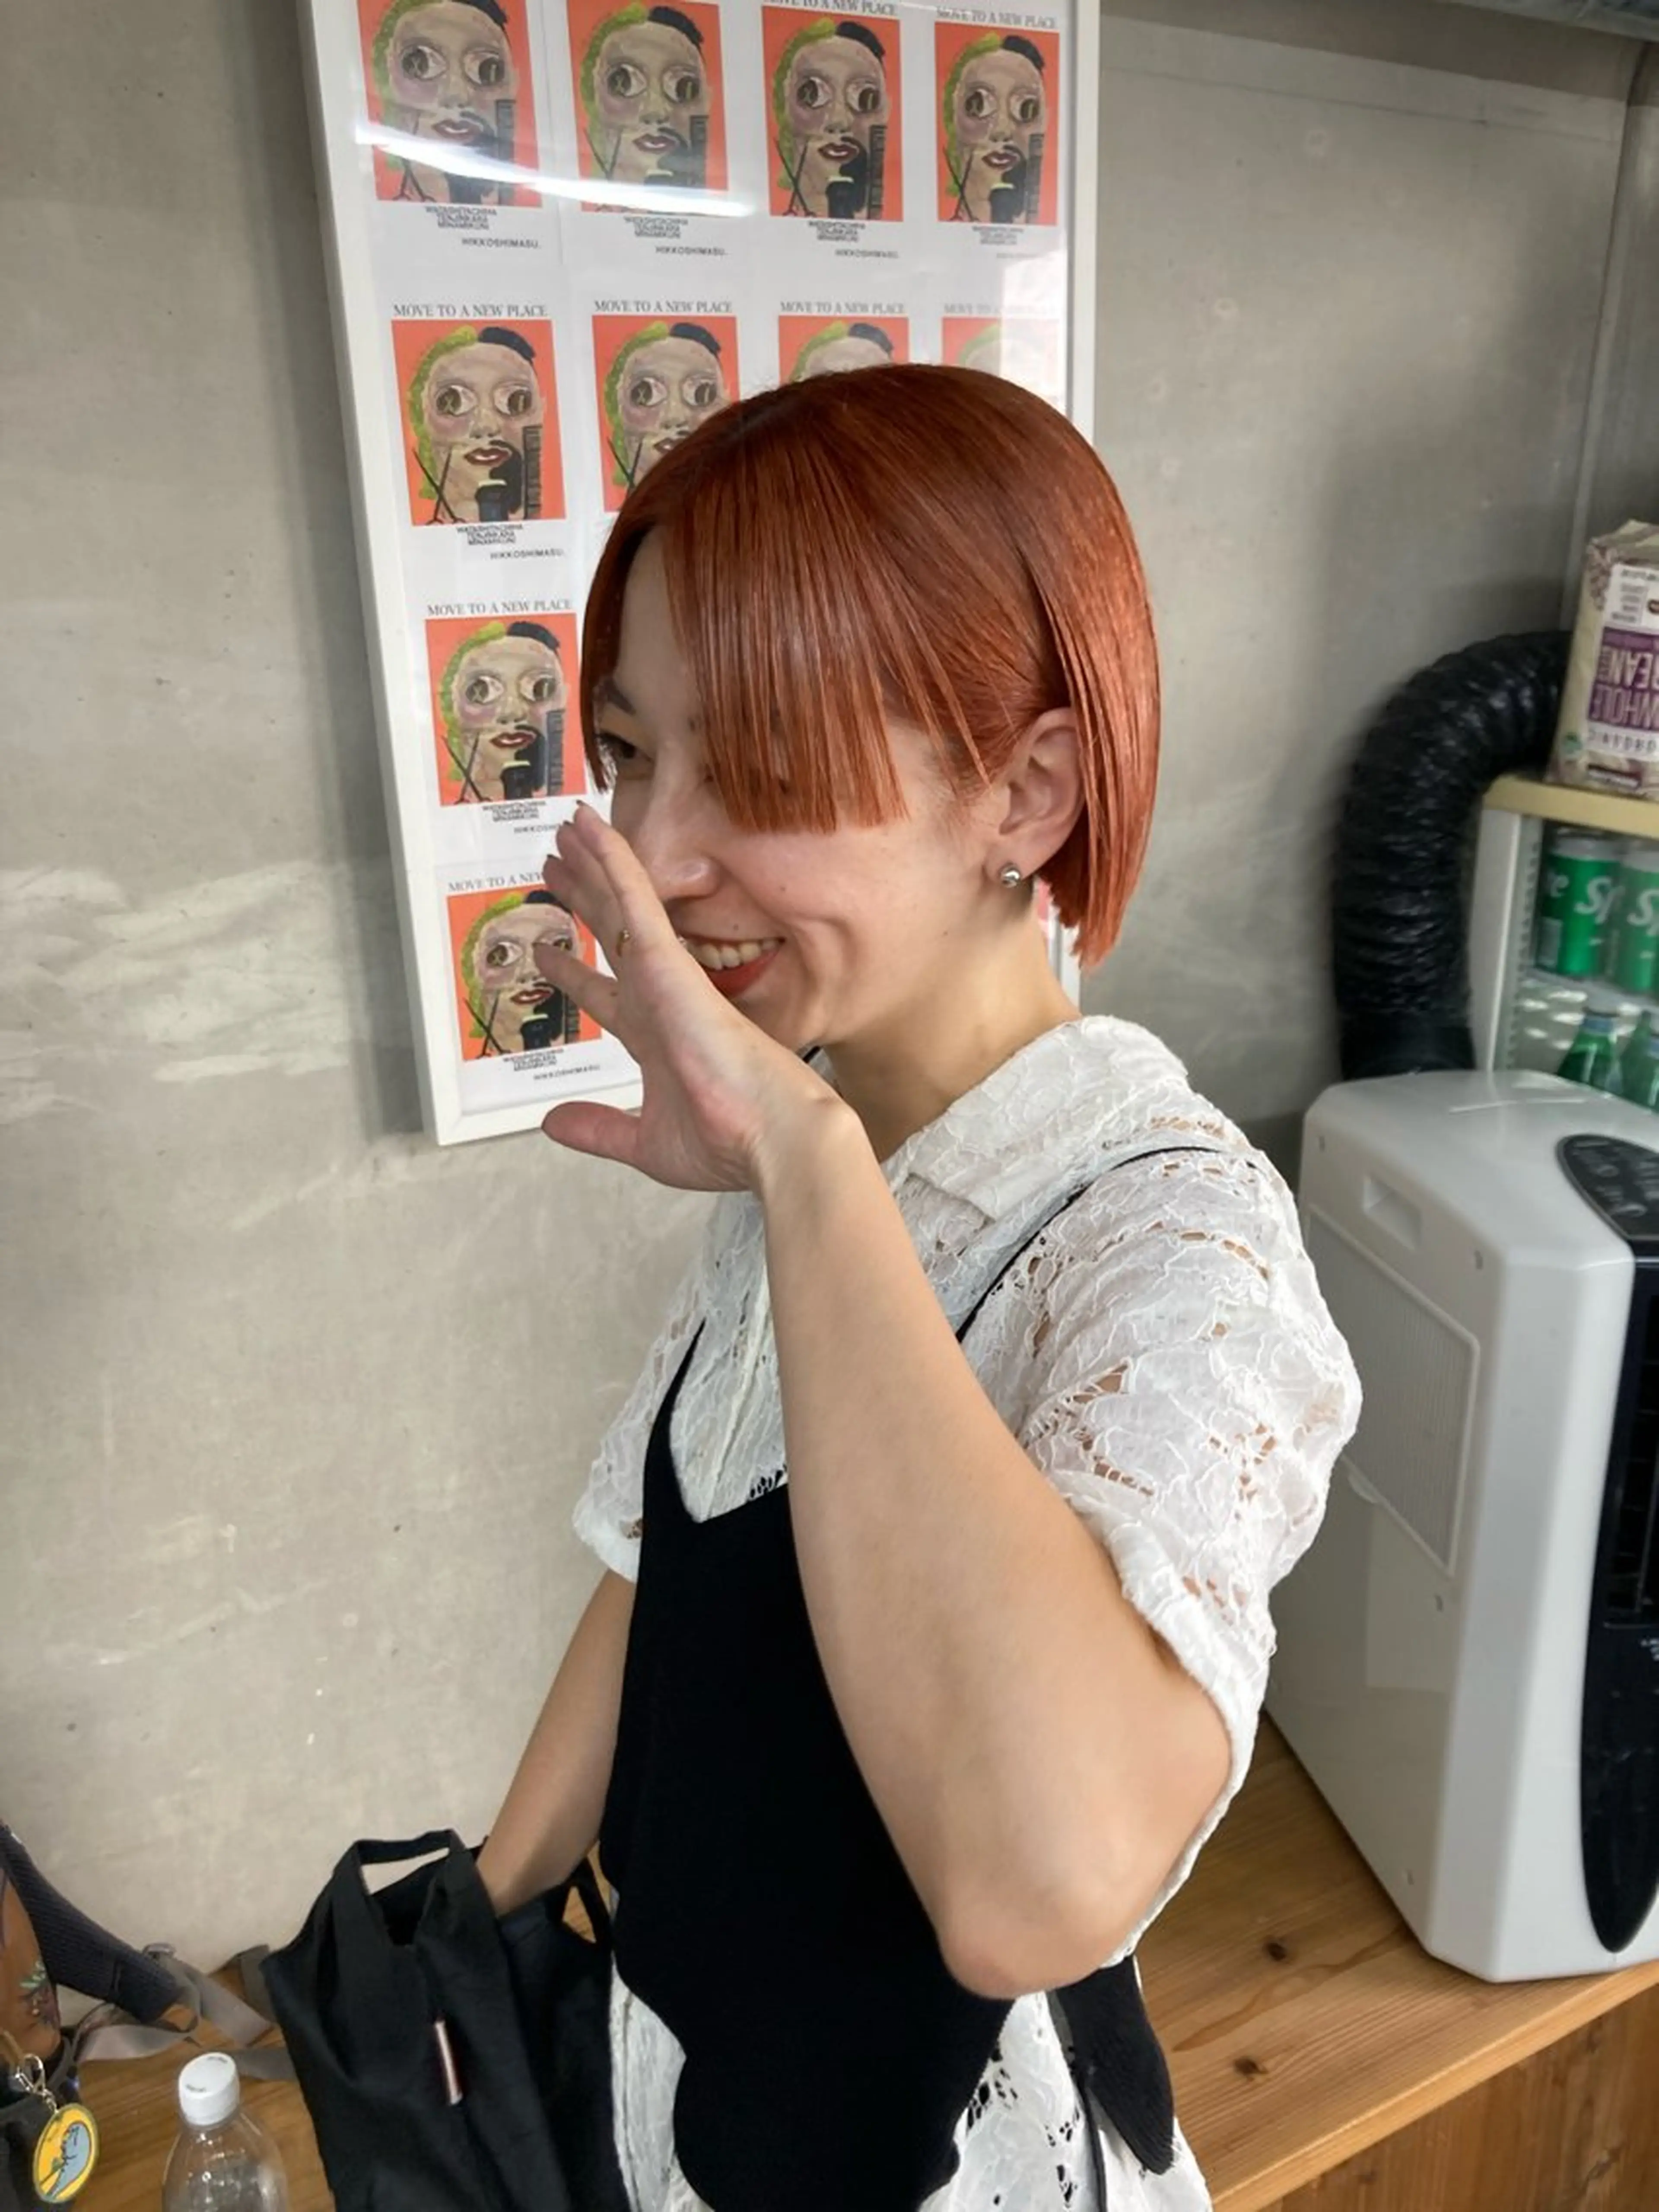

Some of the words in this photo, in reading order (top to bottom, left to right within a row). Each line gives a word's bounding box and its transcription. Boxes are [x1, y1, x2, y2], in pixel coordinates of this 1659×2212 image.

[393, 304, 433, 317] MOVE
[436, 305, 456, 317] TO
[461, 305, 470, 317] A
[473, 305, 504, 317] NEW
[507, 305, 548, 317] PLACE
[594, 300, 630, 312] MOVE
[634, 300, 651, 312] TO
[654, 301, 663, 312] A
[665, 301, 693, 312] NEW
[696, 301, 732, 313] PLACE
[427, 604, 464, 616] MOVE
[467, 604, 486, 615] TO
[489, 603, 499, 613] A
[501, 601, 531, 613] NEW
[534, 599, 572, 611] PLACE
[486, 876, 505, 887] TO
[508, 874, 517, 885] A
